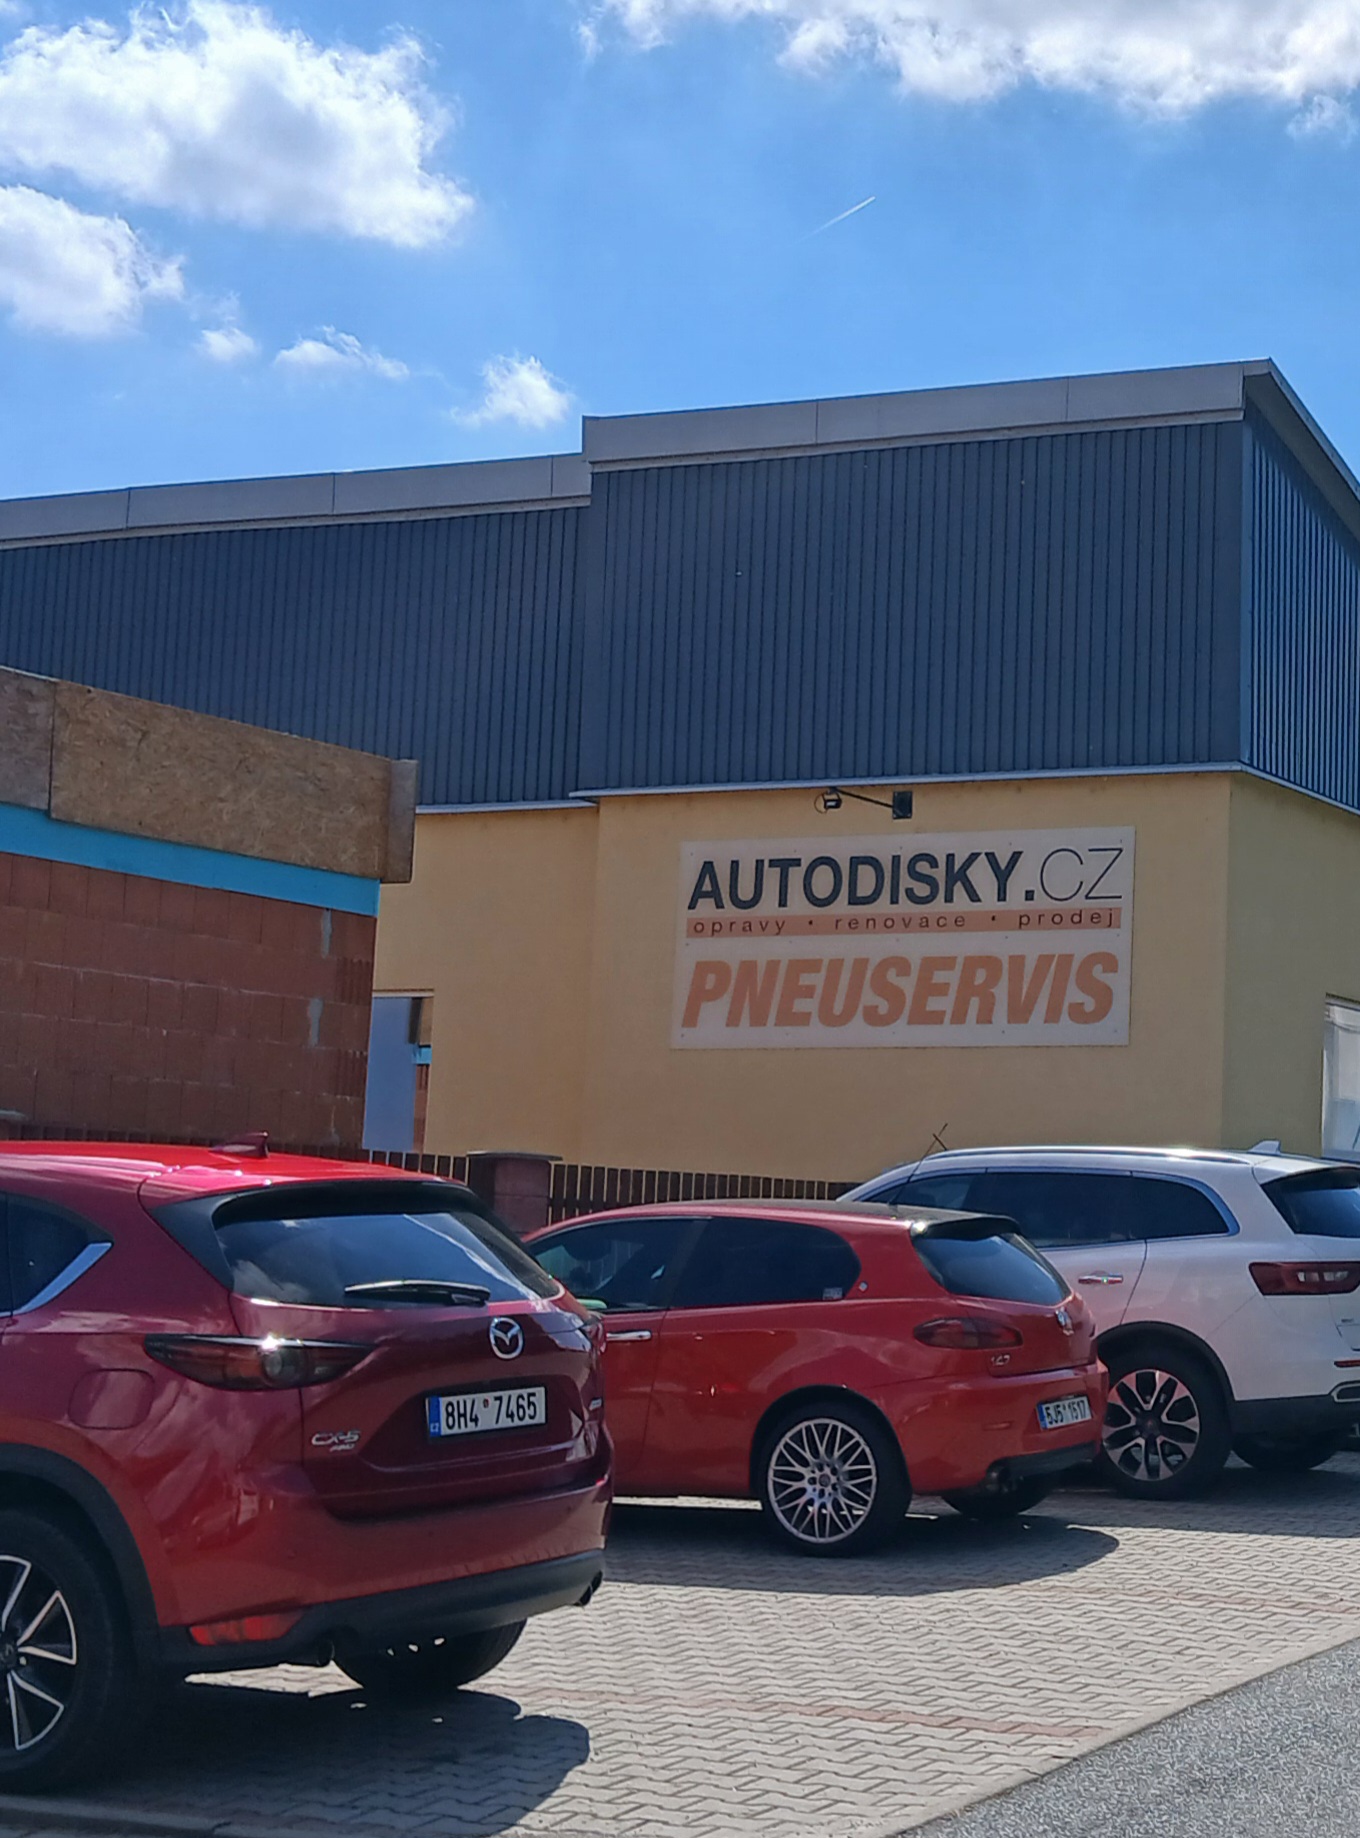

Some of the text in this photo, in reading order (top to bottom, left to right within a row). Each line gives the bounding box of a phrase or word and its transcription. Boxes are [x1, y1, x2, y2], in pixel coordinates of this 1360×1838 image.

[687, 847, 1124, 910] AUTODISKY.CZ
[693, 909, 1116, 936] opravy renovace prodej
[681, 951, 1120, 1028] PNEUSERVIS
[445, 1391, 538, 1431] 8H4 7465
